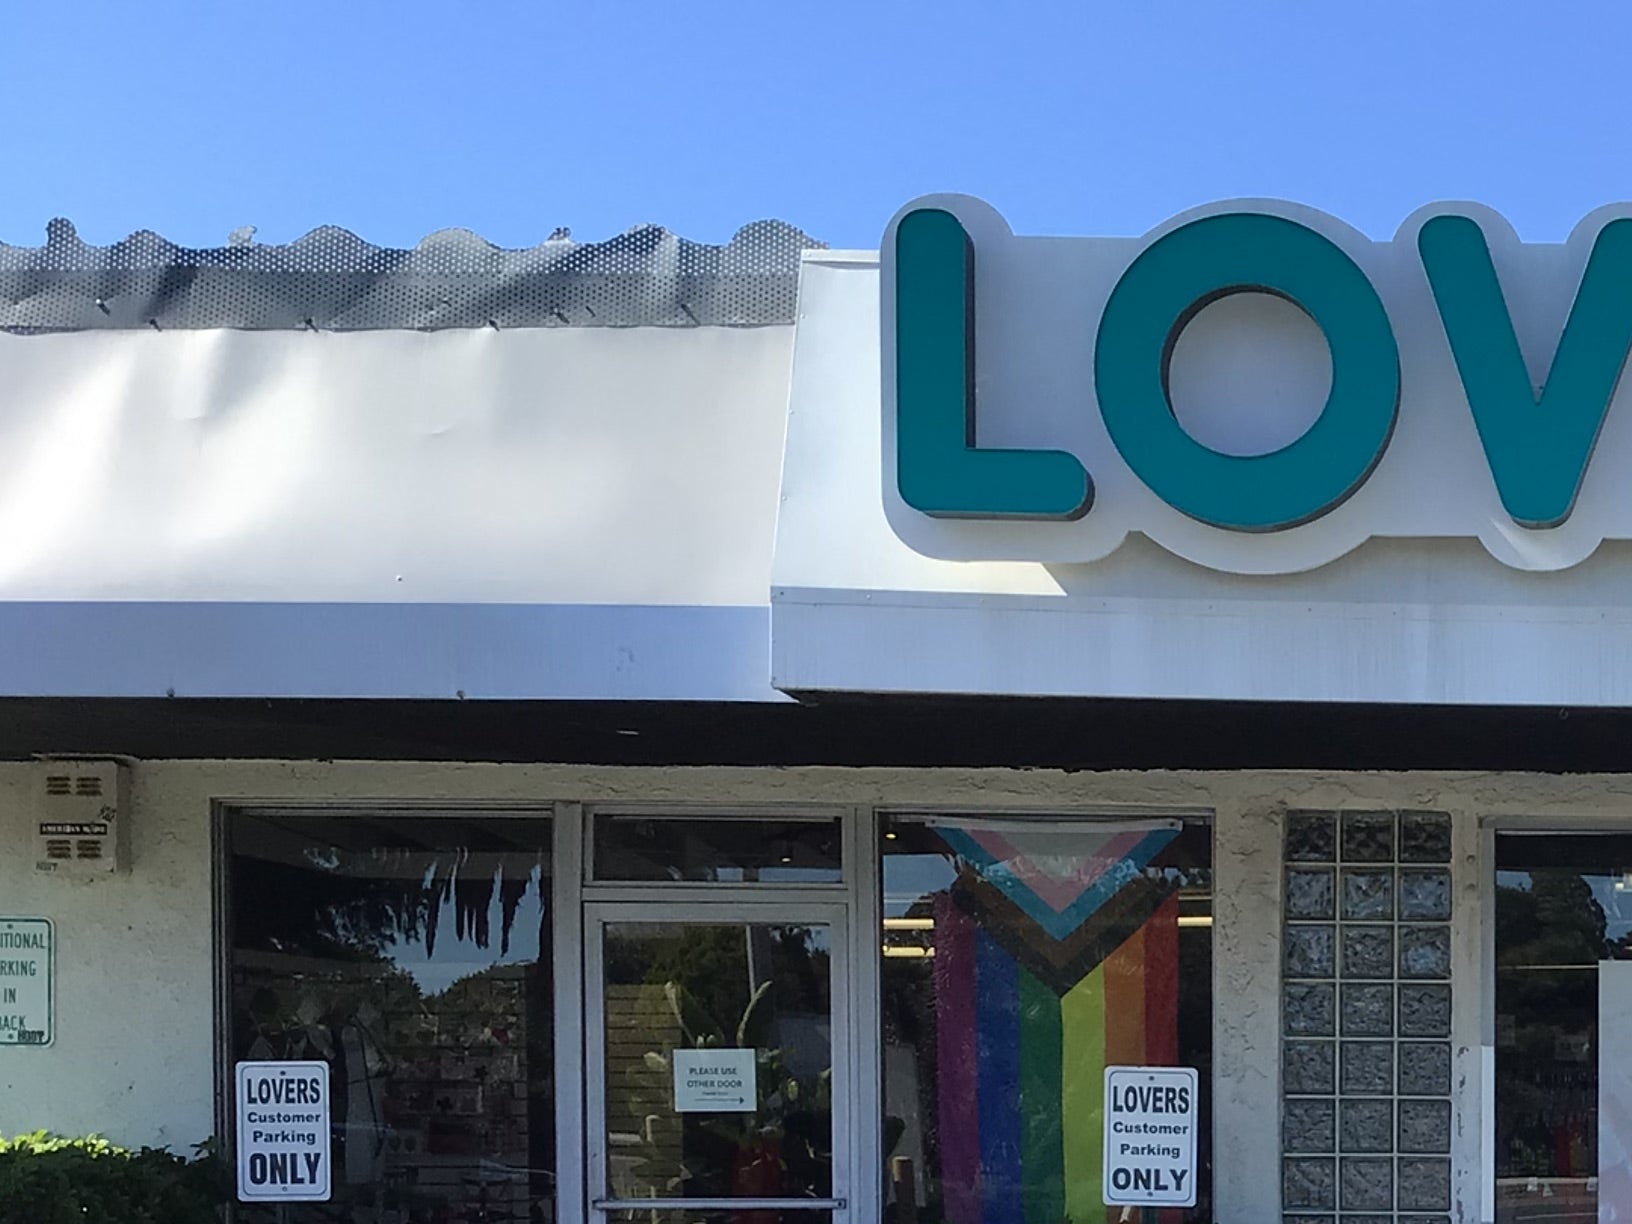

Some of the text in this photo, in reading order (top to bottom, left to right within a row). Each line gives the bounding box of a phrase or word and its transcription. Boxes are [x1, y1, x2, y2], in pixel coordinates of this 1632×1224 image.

[4, 988, 16, 1003] IN
[689, 1067, 737, 1075] PLEASE USE
[247, 1078, 321, 1104] LOVERS
[687, 1080, 742, 1088] OTHER DOOR
[1112, 1085, 1190, 1114] LOVERS
[247, 1112, 321, 1123] Customer
[1113, 1121, 1189, 1135] Customer
[253, 1131, 316, 1146] Parking
[1120, 1143, 1181, 1159] Parking
[249, 1152, 321, 1185] ONLY
[1112, 1167, 1188, 1191] ONLY
